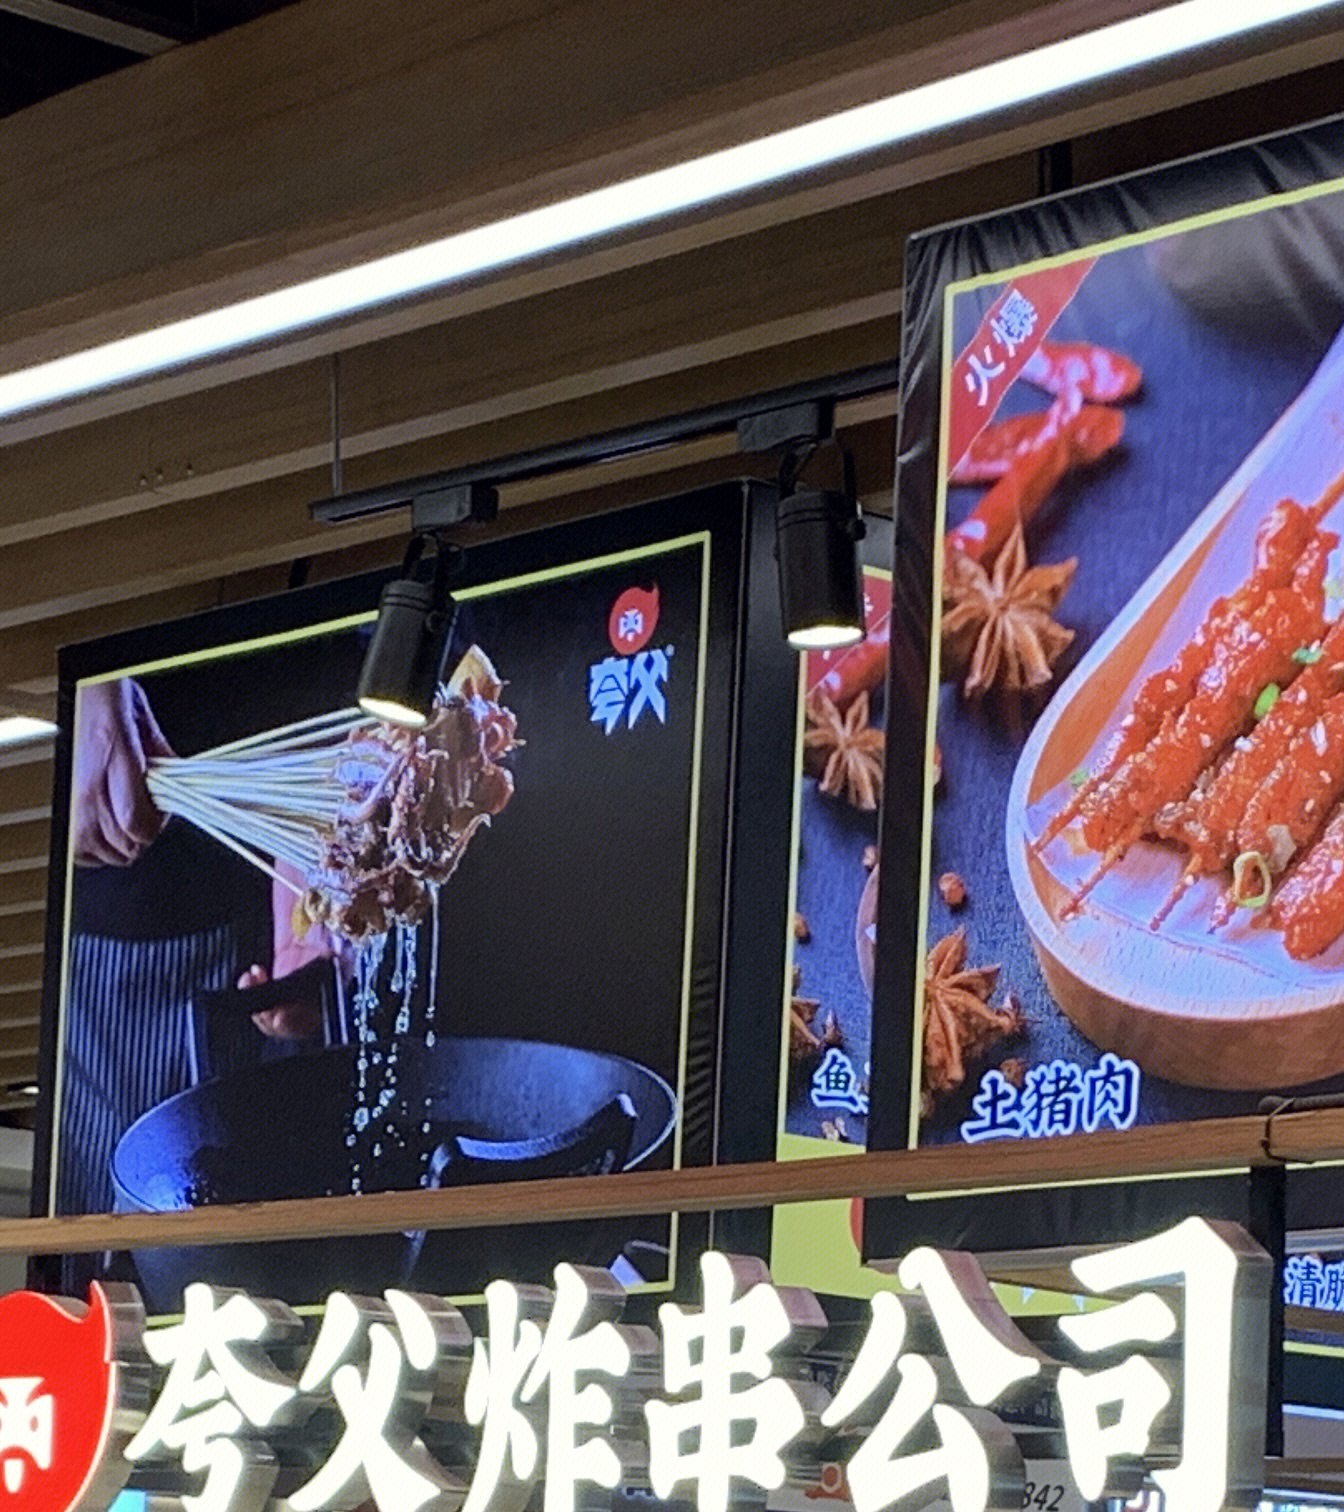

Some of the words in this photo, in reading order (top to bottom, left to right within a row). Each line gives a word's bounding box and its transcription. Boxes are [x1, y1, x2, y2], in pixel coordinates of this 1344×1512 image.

[964, 288, 1038, 406] 火爆
[811, 1048, 869, 1113] 鱼
[961, 1053, 1140, 1143] 土猪肉
